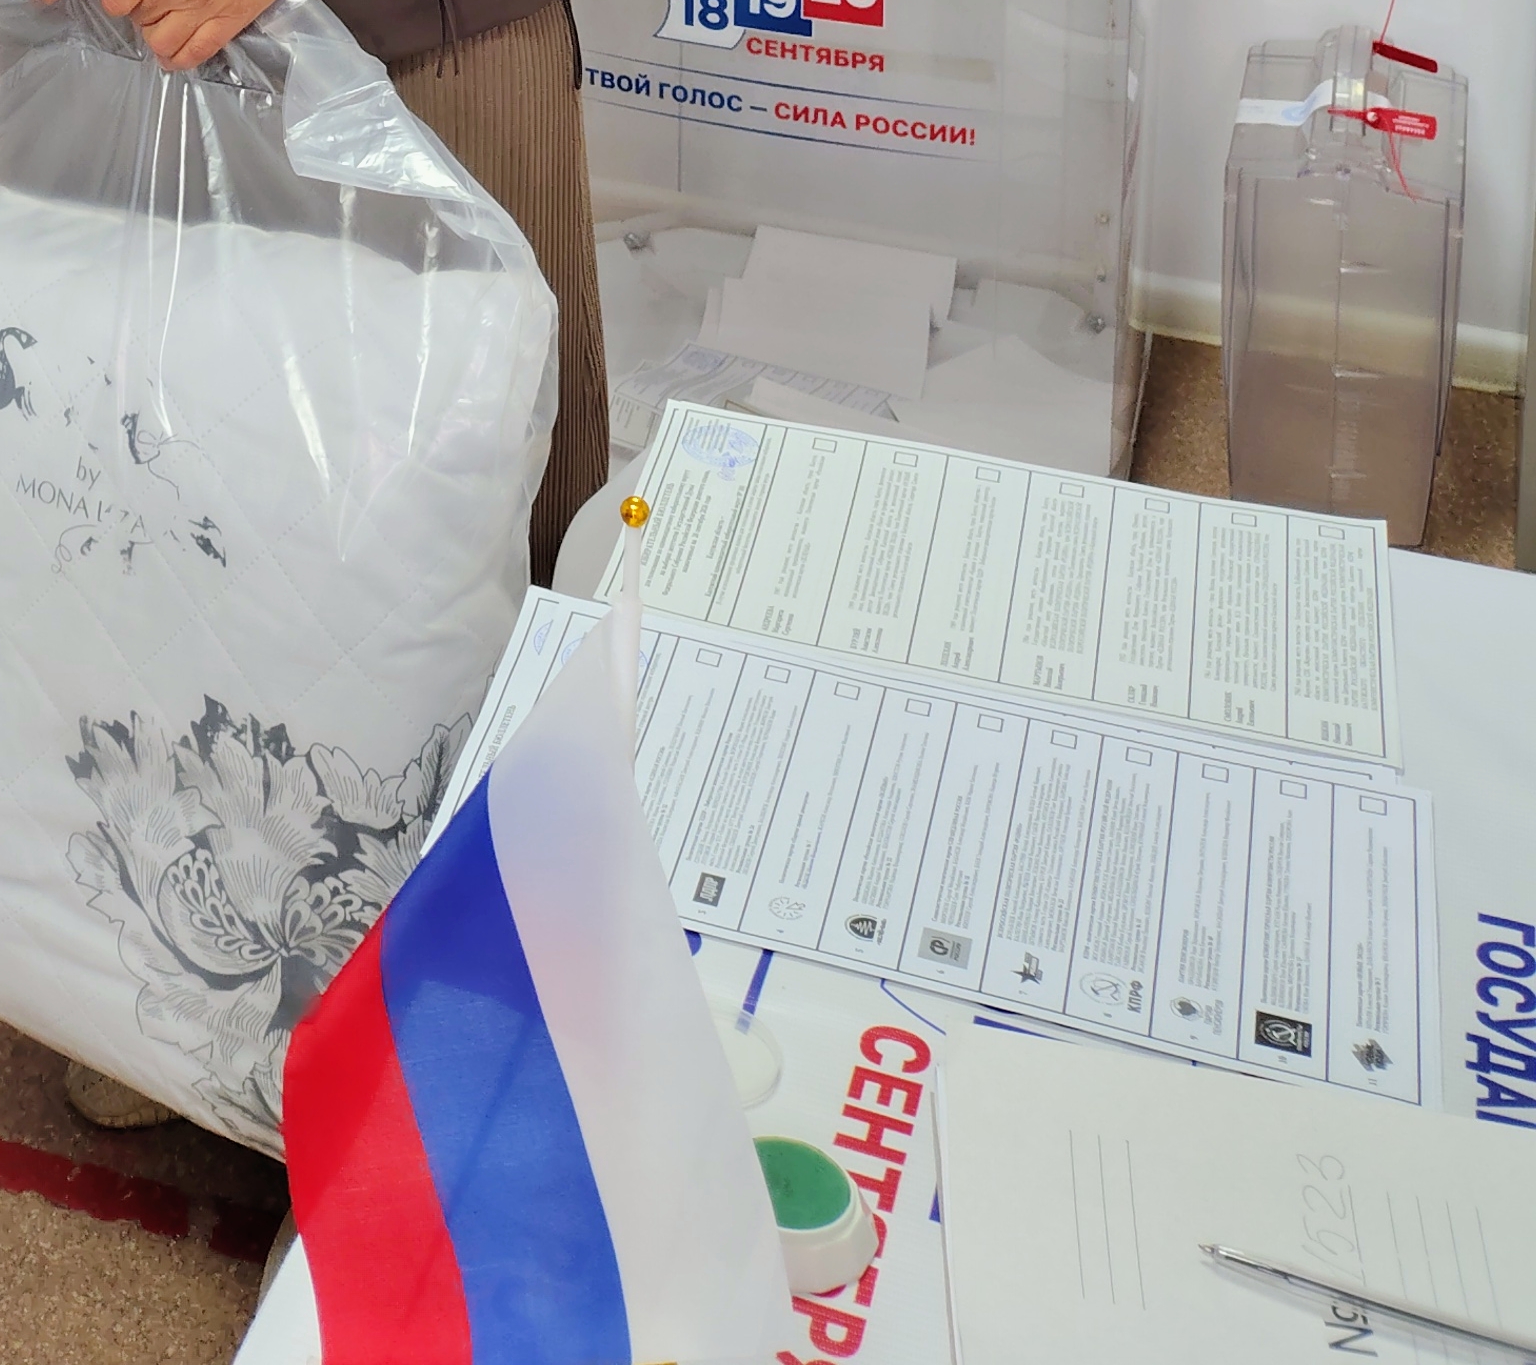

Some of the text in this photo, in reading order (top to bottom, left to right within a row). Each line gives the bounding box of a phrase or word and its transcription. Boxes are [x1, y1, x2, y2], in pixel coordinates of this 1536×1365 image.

[746, 36, 885, 72] СЕНТЯБРЯ
[585, 67, 650, 97] ТВОЙ
[659, 82, 743, 113] ГОЛОС
[774, 101, 847, 130] СИЛА
[855, 114, 976, 146] РОССИИ!
[76, 456, 101, 491] by
[16, 473, 146, 536] MONA LZA
[1127, 980, 1144, 1014] КПРФ
